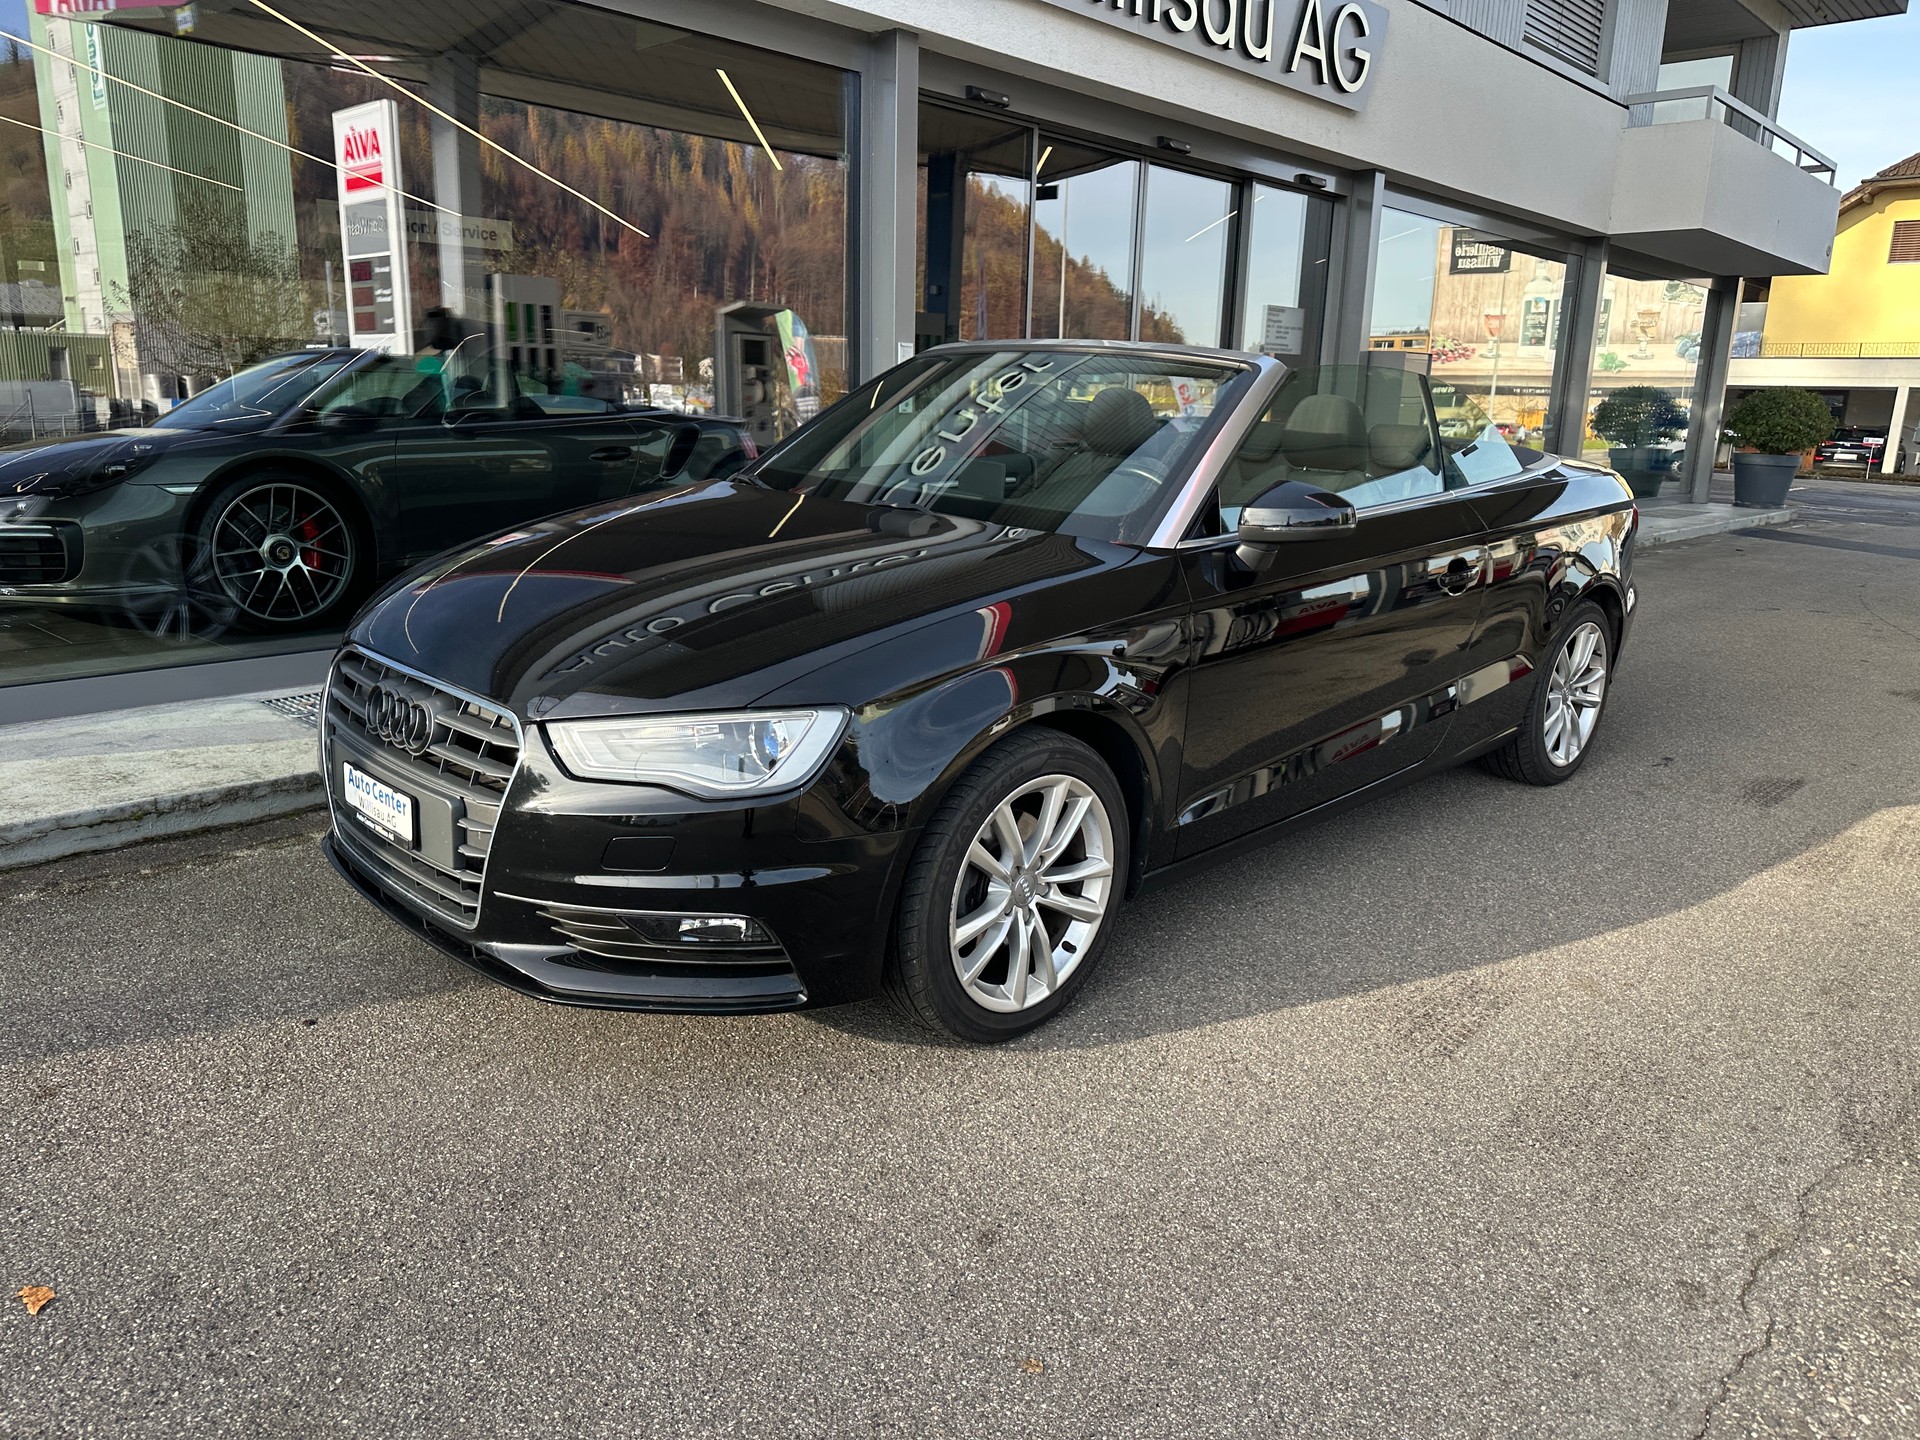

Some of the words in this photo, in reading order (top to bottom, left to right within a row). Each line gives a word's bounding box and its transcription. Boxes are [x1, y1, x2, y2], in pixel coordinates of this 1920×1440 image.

[1286, 0, 1372, 93] AG
[442, 221, 498, 242] Service
[387, 812, 397, 829] AG
